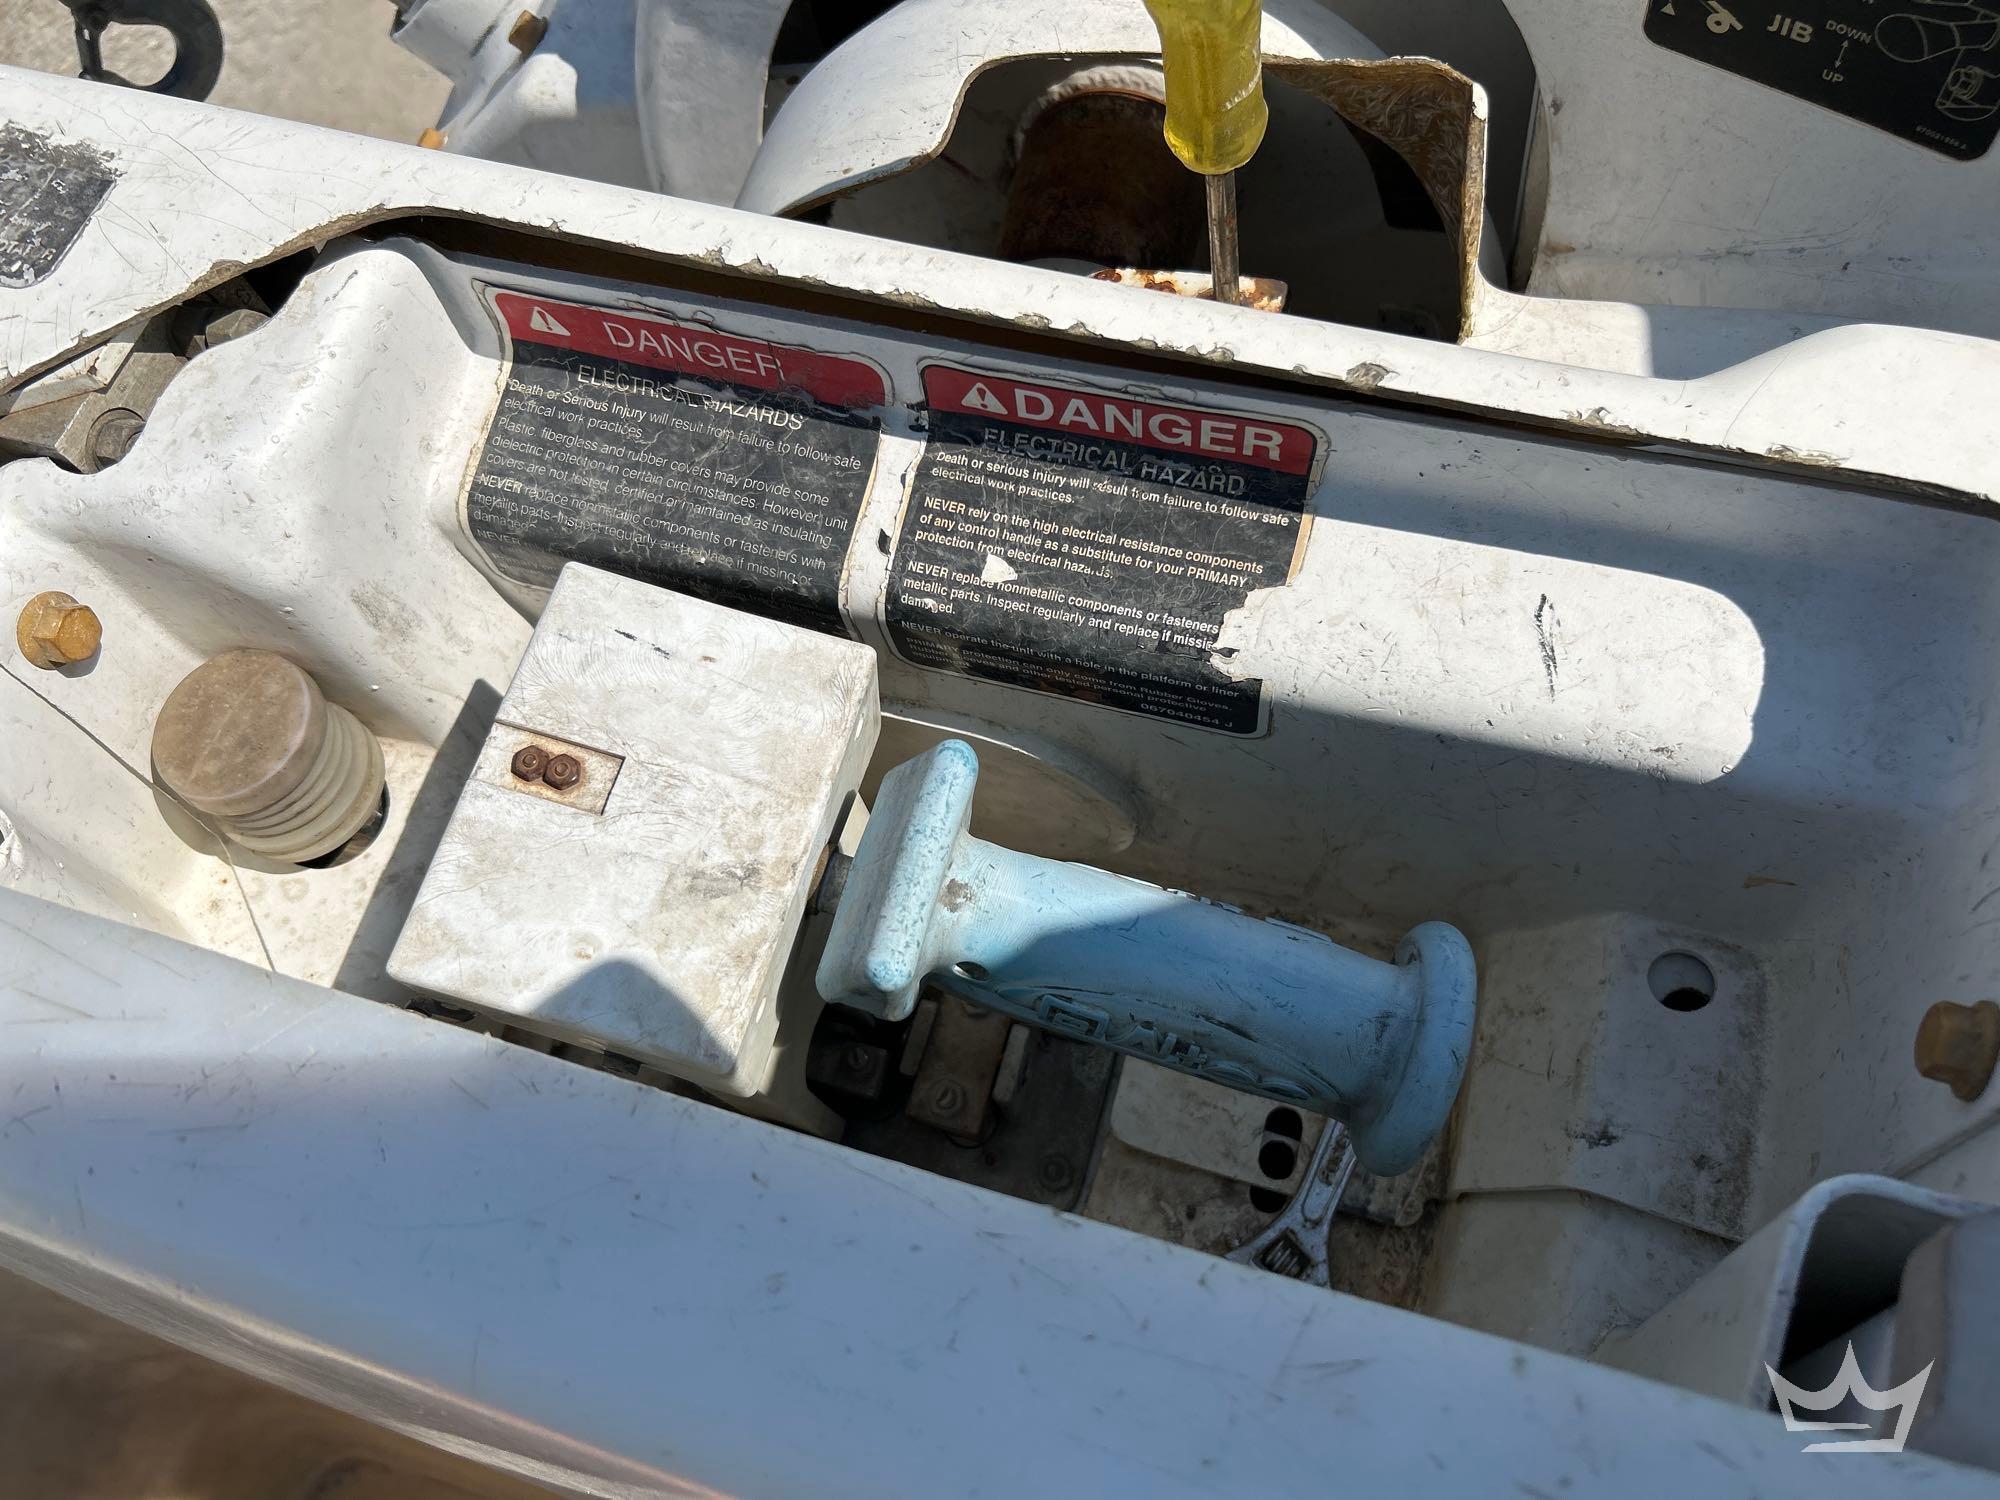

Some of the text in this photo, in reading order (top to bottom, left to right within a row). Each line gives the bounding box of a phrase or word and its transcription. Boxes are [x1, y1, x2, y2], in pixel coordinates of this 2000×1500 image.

[1766, 14, 1872, 44] JIB DOWN
[1822, 69, 1844, 82] UP
[602, 321, 785, 382] DANGER
[504, 397, 556, 418] electrical
[558, 411, 585, 424] work
[577, 364, 698, 408] ELECTRICAL
[509, 379, 861, 470] Death or Serious Injury will result from failure to follow safe
[1014, 388, 1283, 462] DANGER
[492, 435, 543, 457] dielectric
[545, 449, 606, 470] protection
[608, 463, 619, 475] in
[622, 467, 663, 485] certain
[666, 478, 758, 509] circumstances.
[825, 517, 848, 531] unit
[541, 427, 598, 450] fiberglass
[600, 443, 625, 458] and
[627, 450, 668, 467] rubber
[670, 461, 711, 478] covers
[714, 470, 741, 488] may
[743, 478, 790, 497] provide
[794, 490, 830, 507] some
[932, 467, 1075, 504] electrical work practices.
[936, 452, 1289, 527] Death or serious injury will result from failure to follow safe
[984, 427, 1246, 496] ELECTRICAL HAZARD
[479, 473, 826, 570] NEVER replace nonmetallic components or fasteners with
[486, 453, 524, 470] covers
[526, 463, 546, 475] are
[549, 468, 568, 481] not
[615, 483, 664, 503] certified
[666, 497, 677, 507] or
[680, 500, 751, 526] maintained
[753, 519, 769, 531] as
[772, 519, 832, 549] insulating
[476, 529, 521, 545] NEVER
[605, 526, 657, 549] regularly
[737, 557, 744, 569] if
[747, 562, 796, 584] missing
[800, 576, 812, 585] or
[914, 530, 974, 551] protection
[977, 541, 1004, 555] from
[1007, 549, 1061, 569] electrical
[920, 513, 1248, 588] of any control handle as a substitute for your PRIMARY
[924, 496, 1264, 574] NEVER rely on the high electrical resistance components
[903, 578, 948, 596] metallic
[950, 588, 982, 604] parts.
[987, 594, 1030, 612] Inspect
[1033, 607, 1085, 627] regularly
[1088, 617, 1112, 630] and
[1114, 621, 1159, 640] replace
[1162, 630, 1171, 641] if
[908, 560, 1219, 634] NEVER replace nonmetallic components or fasteners
[901, 621, 941, 635] NEVER
[944, 631, 988, 645] operate
[990, 640, 1009, 650] the
[1012, 646, 1034, 656] unit
[1037, 652, 1061, 661] with
[1074, 658, 1101, 670] hole
[1104, 665, 1115, 673] in
[1119, 667, 1138, 677] the
[1141, 673, 1192, 688] platform
[1195, 684, 1208, 692] or
[1212, 686, 1240, 698] liner
[962, 649, 1020, 665] protection
[1023, 662, 1043, 671] can
[1046, 667, 1071, 678] only
[1074, 674, 1106, 684] come
[1109, 681, 1136, 690] from
[1140, 687, 1182, 699] Rubber
[1023, 669, 1051, 679] other
[1093, 684, 1144, 699] personal
[1147, 696, 1207, 711] protective
